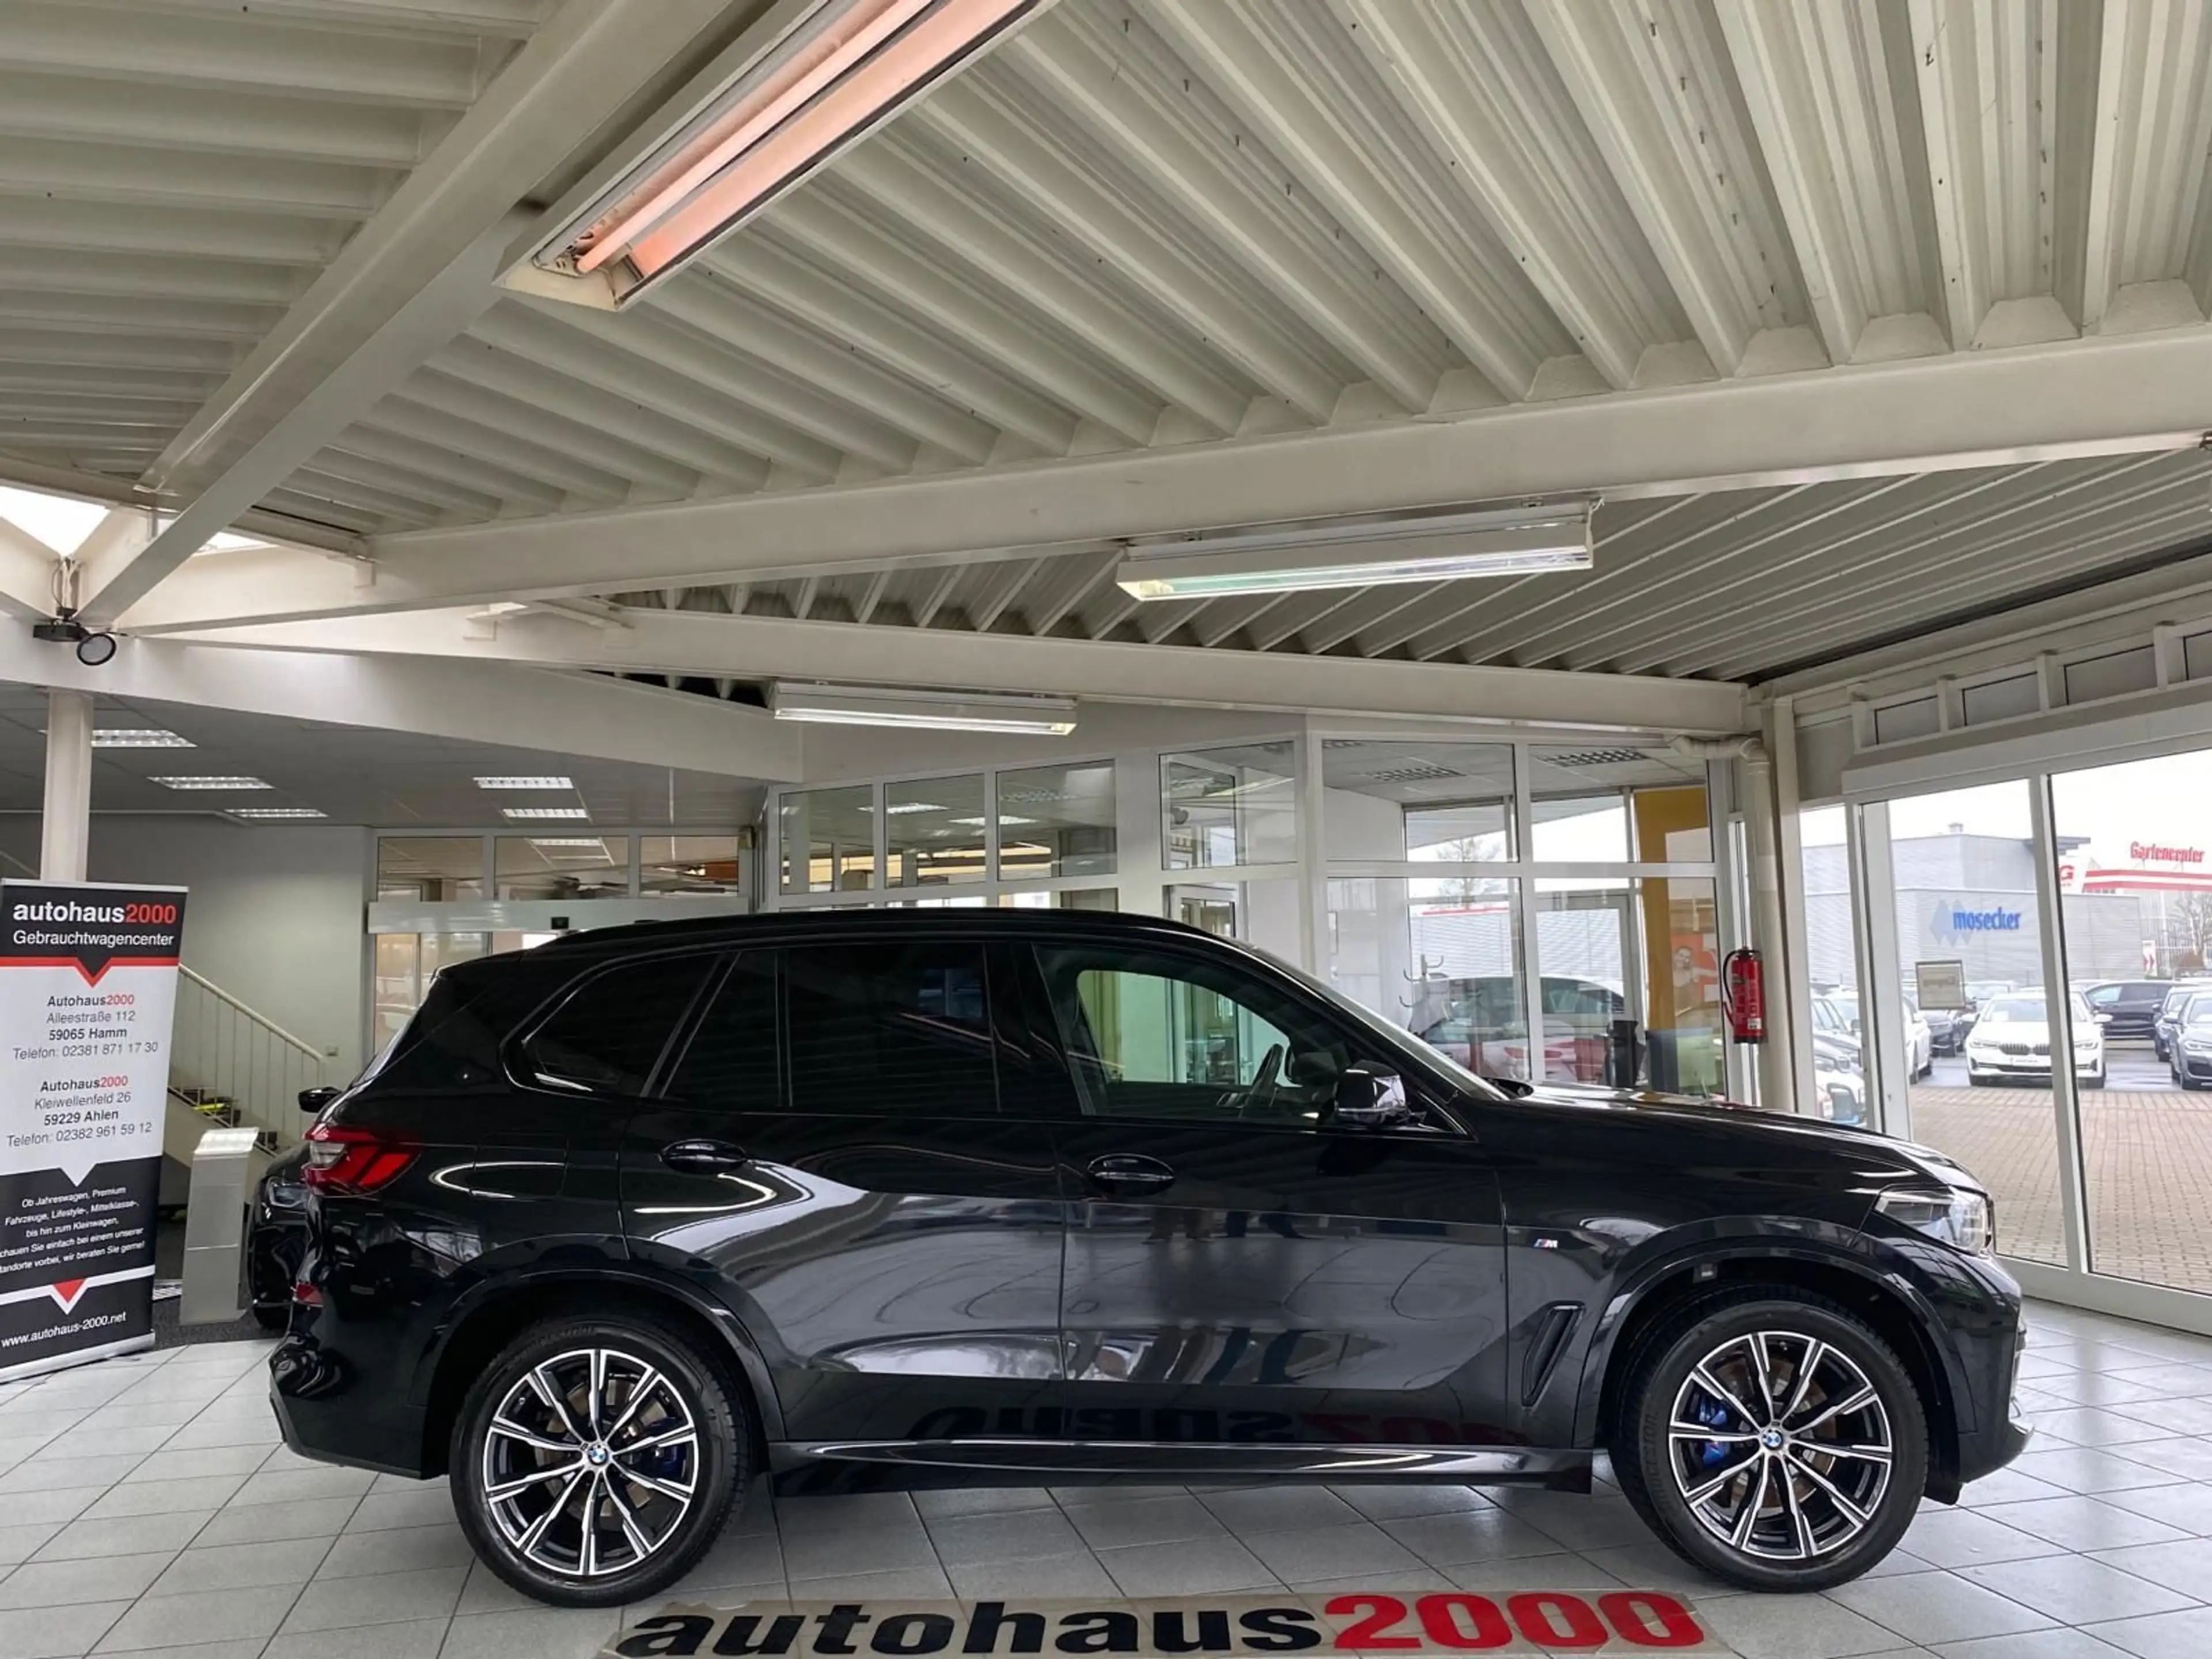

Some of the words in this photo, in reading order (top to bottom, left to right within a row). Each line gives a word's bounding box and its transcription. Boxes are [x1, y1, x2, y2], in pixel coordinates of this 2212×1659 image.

[13, 902, 176, 924] autohaus2000
[1953, 906, 2021, 930] mosecker
[13, 930, 174, 948] Gebrauchtwagencenter
[47, 994, 135, 1007] Autohaus2000
[46, 1012, 112, 1024] Alleestraße
[116, 1010, 135, 1022] 112
[49, 1029, 85, 1040] 59065
[89, 1028, 127, 1039] Hamm
[13, 1047, 58, 1059] Telefon:
[62, 1045, 98, 1057] 02381
[103, 1043, 123, 1055] 871
[128, 1043, 142, 1053] 17
[145, 1041, 158, 1052] 30
[40, 1075, 128, 1092] Autohaus2000
[116, 1092, 131, 1103] 26
[44, 1112, 81, 1126] 59229
[84, 1109, 119, 1122] Ahlen
[7, 1134, 52, 1147] Telefon:
[56, 1127, 93, 1141] 02382
[96, 1126, 116, 1138] 961
[120, 1123, 135, 1135] 59
[139, 1122, 152, 1134] 12
[22, 1199, 34, 1207] Ob
[25, 1229, 38, 1238] bis
[40, 1227, 52, 1236] hin
[54, 1224, 71, 1233] zum
[1, 1312, 126, 1347] www.autohaus-2000.net
[616, 1592, 1704, 1657] autohaus2000
